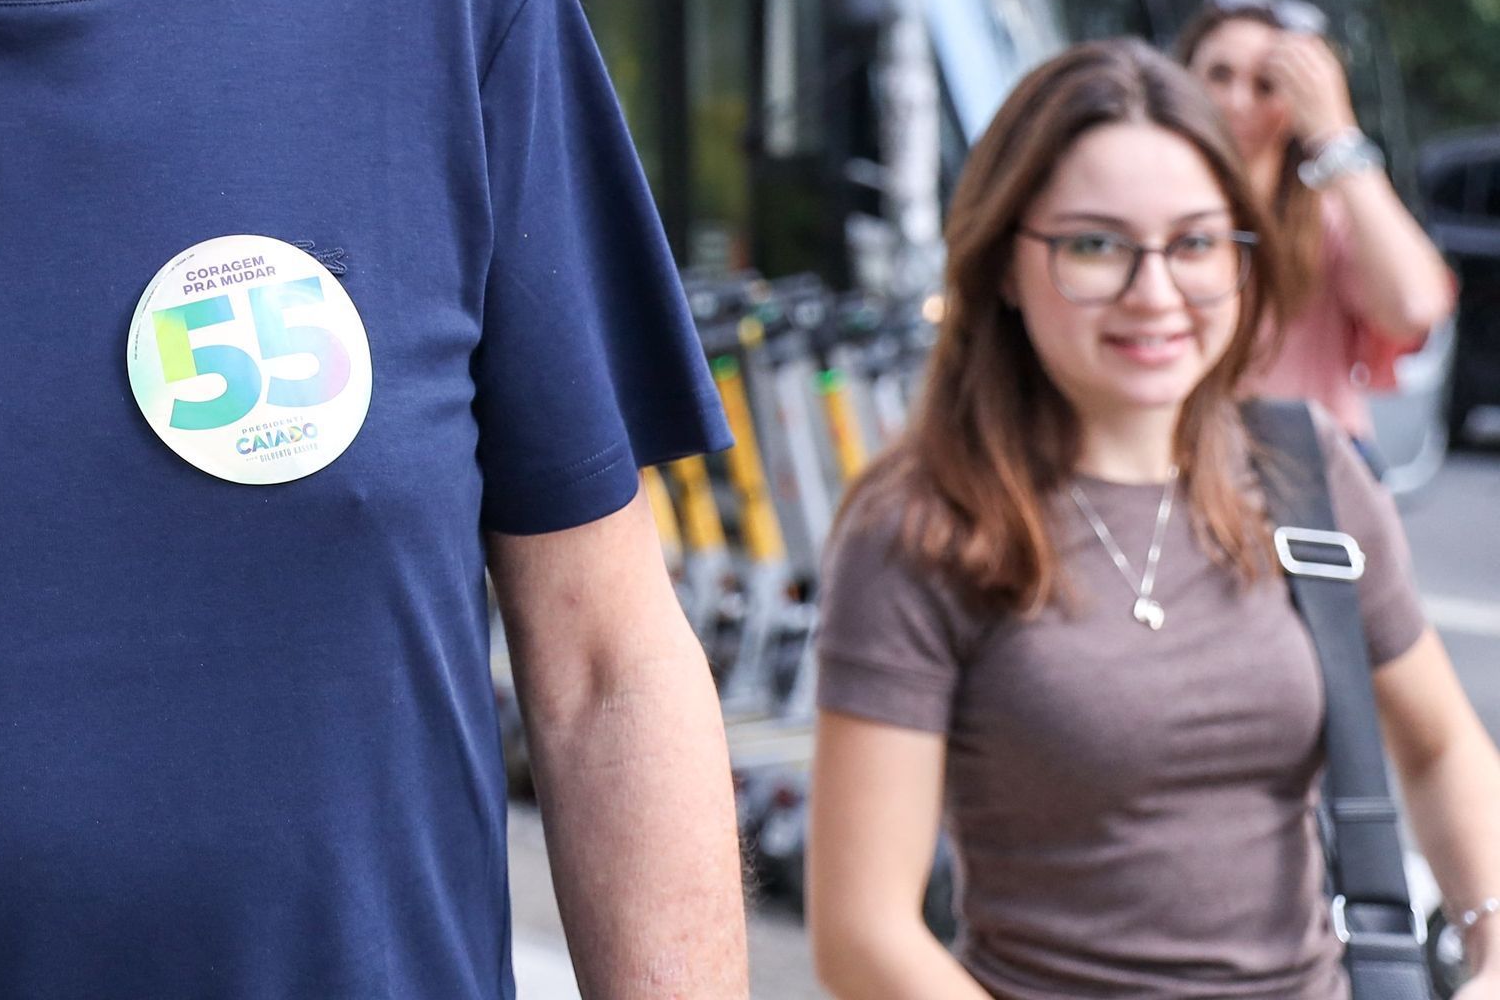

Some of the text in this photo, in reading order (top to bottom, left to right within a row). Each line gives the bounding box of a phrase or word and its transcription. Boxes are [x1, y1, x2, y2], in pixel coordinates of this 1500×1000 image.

[182, 266, 276, 295] PRA MUDAR
[185, 255, 265, 282] CORAGEM
[152, 276, 351, 431] 55
[235, 422, 318, 455] CAIADO
